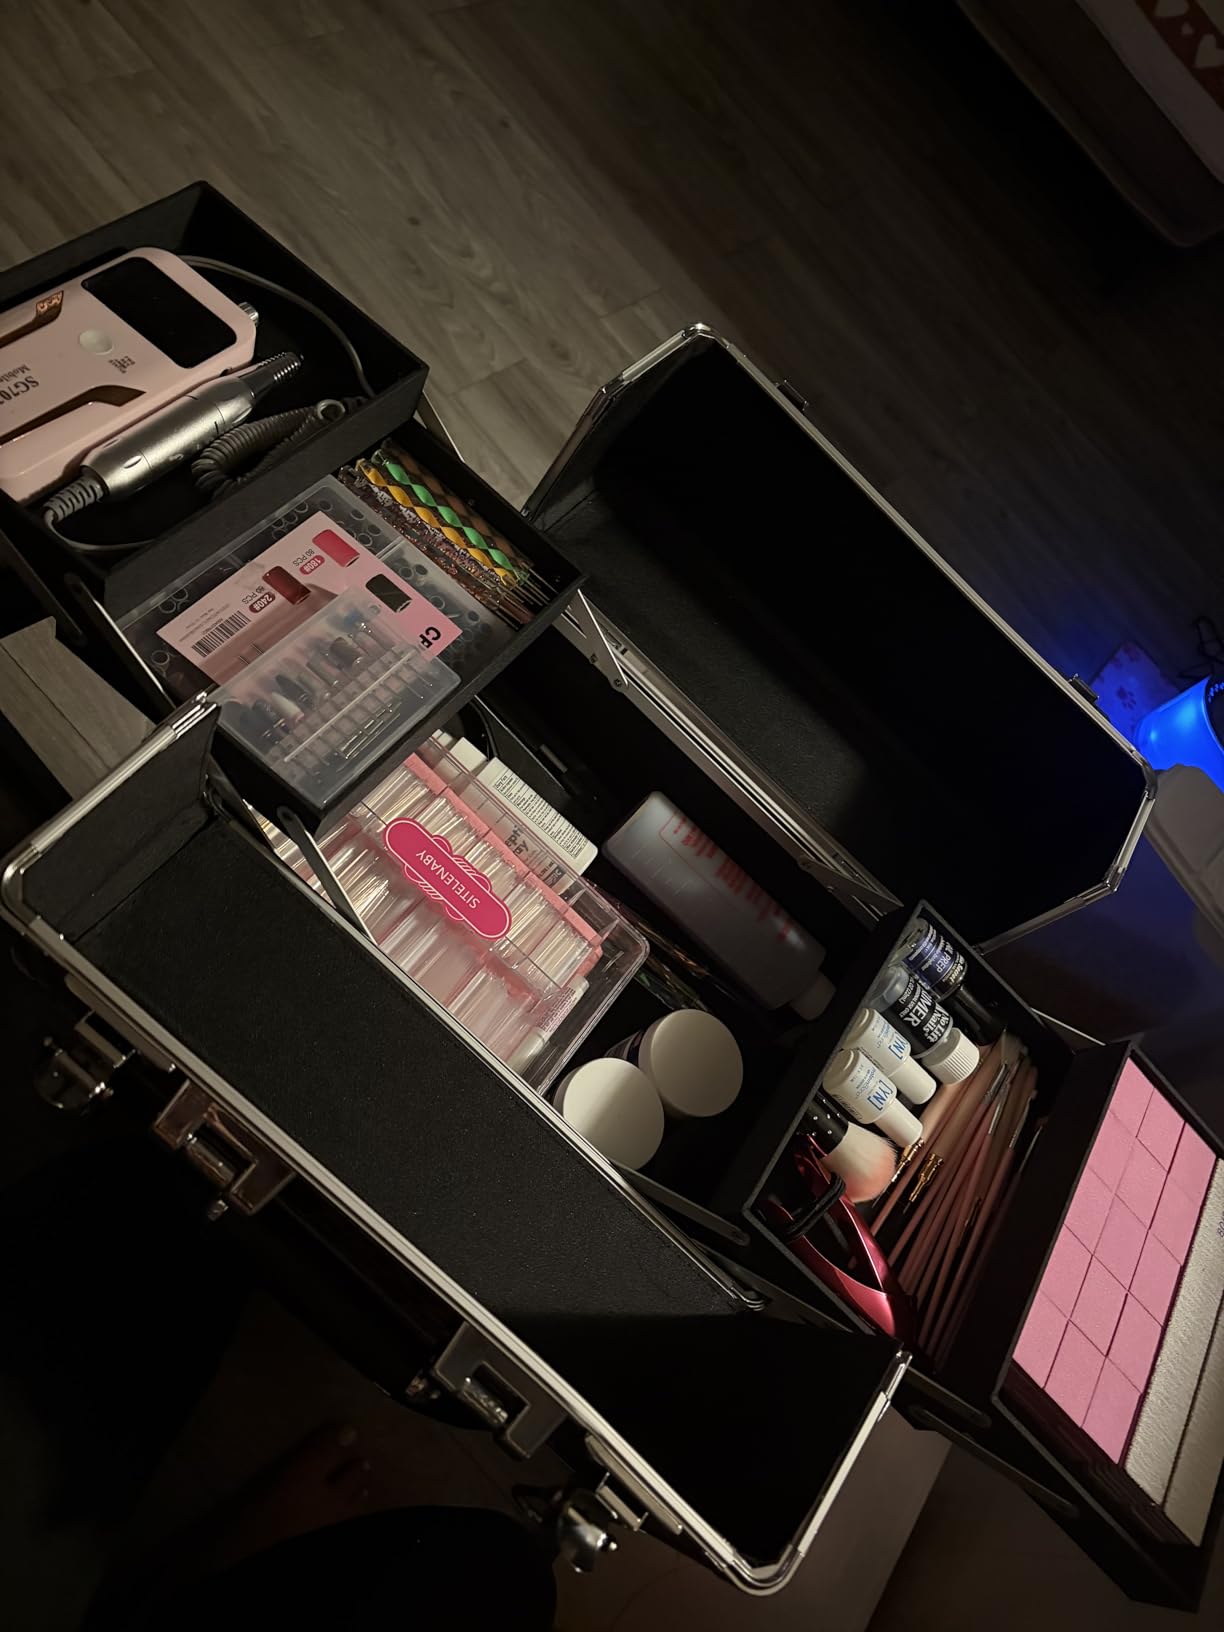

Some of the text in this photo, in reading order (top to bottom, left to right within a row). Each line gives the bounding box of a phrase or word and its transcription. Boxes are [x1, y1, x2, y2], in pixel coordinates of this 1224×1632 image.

[0, 375, 39, 405] SG70
[293, 555, 307, 567] PCS
[241, 592, 258, 604] PCS
[253, 594, 273, 612] 240#
[416, 850, 480, 909] SITELENABY
[936, 951, 951, 973] PREP
[926, 1024, 945, 1043] Lift
